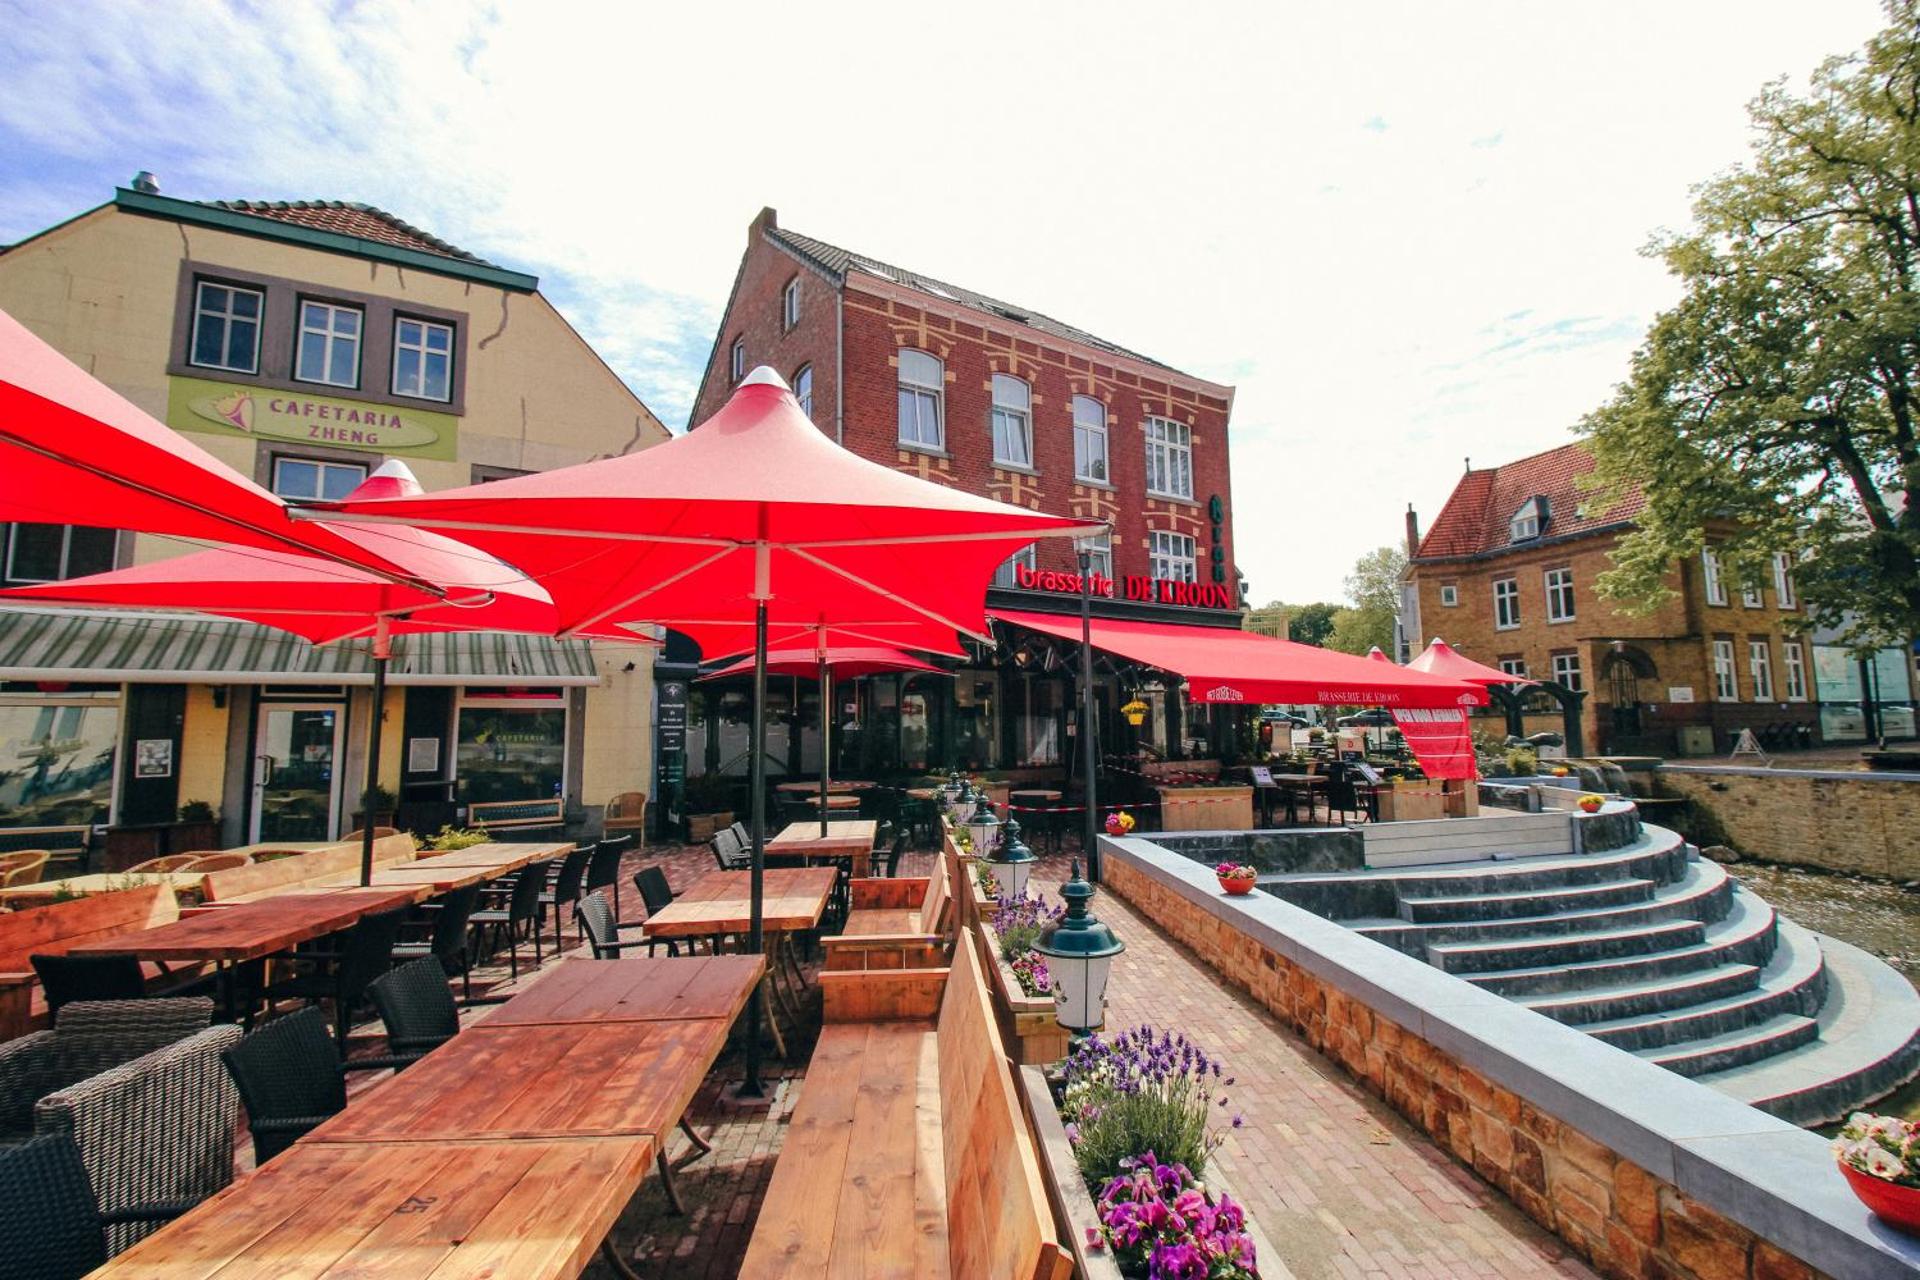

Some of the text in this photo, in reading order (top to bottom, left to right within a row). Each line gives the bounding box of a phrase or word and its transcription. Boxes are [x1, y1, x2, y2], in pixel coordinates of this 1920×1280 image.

[269, 399, 402, 429] CAFETARIA
[308, 424, 379, 444] ZHENG
[1124, 575, 1154, 602] DE
[1157, 579, 1231, 609] KROON
[1317, 690, 1361, 702] BRASSERIE
